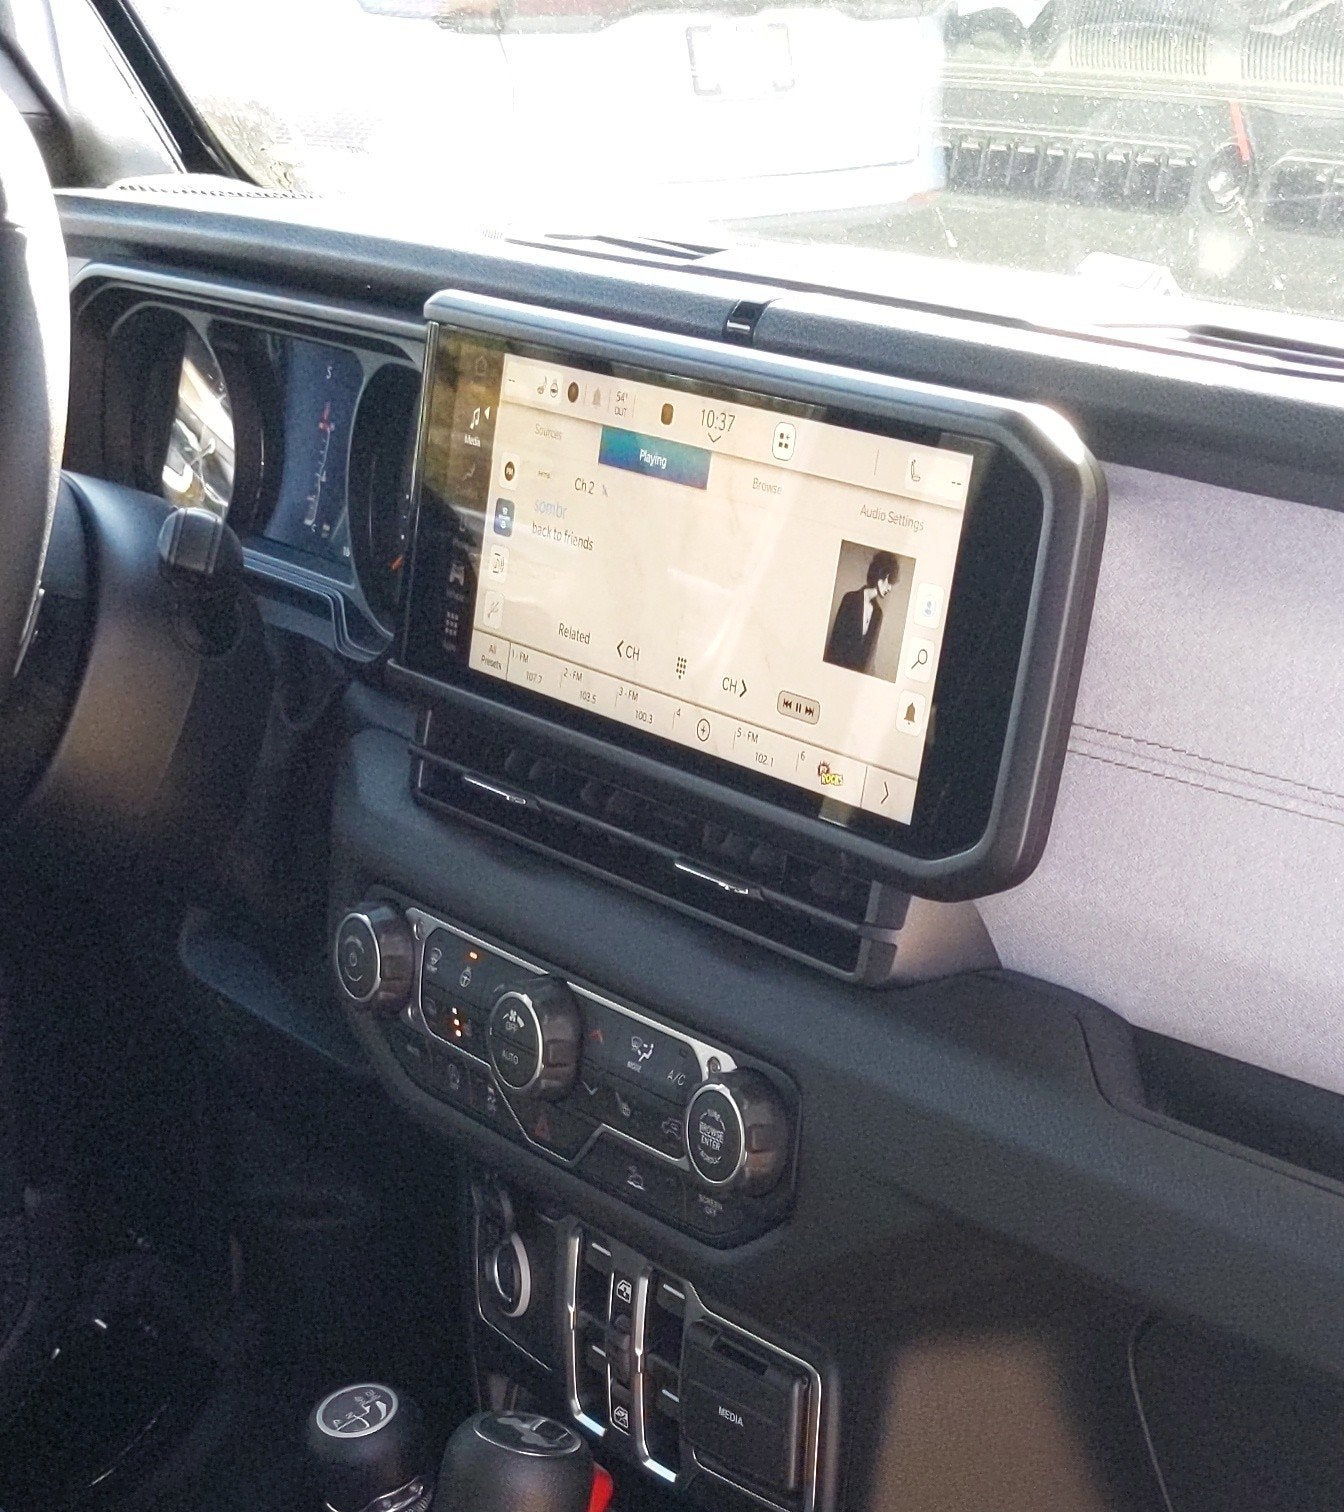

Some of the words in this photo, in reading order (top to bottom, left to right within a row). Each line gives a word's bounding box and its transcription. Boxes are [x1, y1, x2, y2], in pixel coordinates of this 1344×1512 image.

[700, 408, 736, 432] 10:37
[464, 433, 481, 448] Media
[534, 423, 563, 441] Sources
[639, 448, 668, 470] Playing
[574, 477, 587, 492] Ch
[588, 481, 595, 495] 2
[752, 477, 783, 495] Browse
[533, 499, 568, 520] sombr
[860, 504, 886, 521] Audio
[887, 510, 924, 533] Settings
[532, 522, 552, 539] back
[553, 528, 562, 540] to
[564, 529, 594, 551] friends
[558, 622, 591, 645] Related
[625, 645, 641, 662] CH
[722, 676, 738, 694] CH
[718, 1405, 744, 1427] MEDIA
